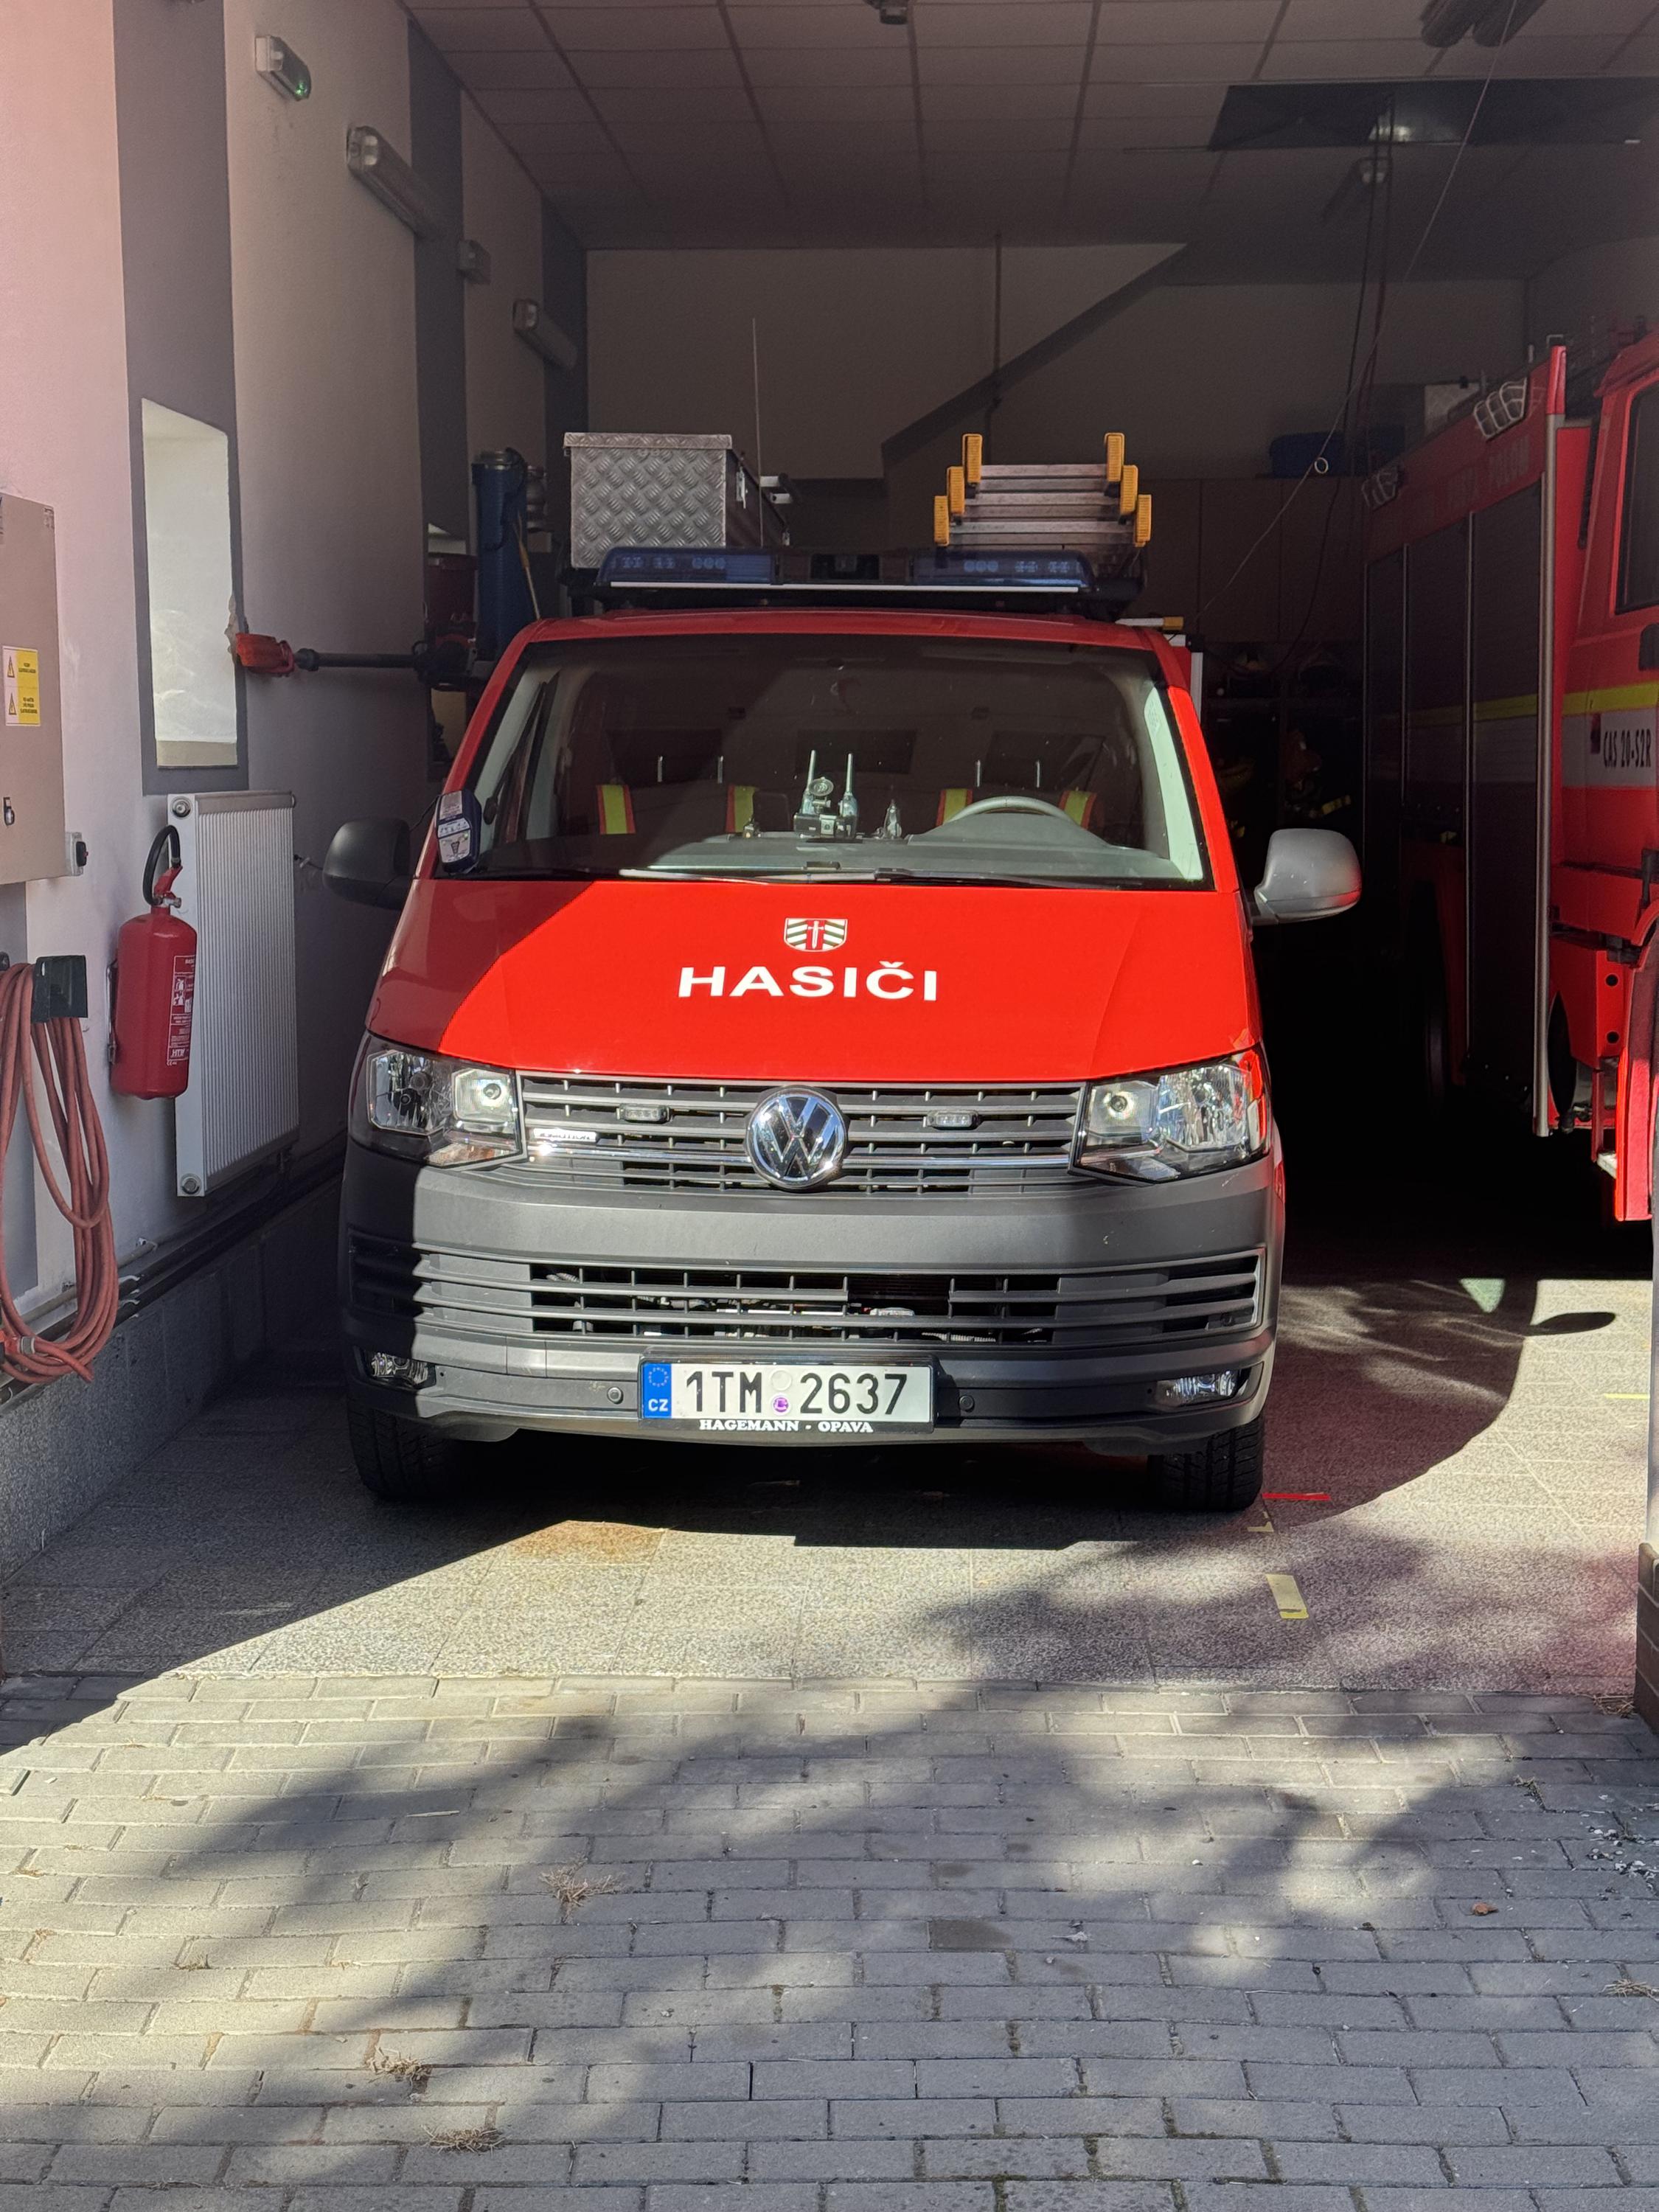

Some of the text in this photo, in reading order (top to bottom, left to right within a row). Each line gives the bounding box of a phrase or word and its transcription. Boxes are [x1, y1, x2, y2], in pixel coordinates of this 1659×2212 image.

[1603, 731, 1618, 768] CAS
[678, 960, 938, 1001] HASIČI
[647, 1398, 669, 1413] CZ
[686, 1371, 908, 1415] 1TM 2637
[699, 1419, 799, 1432] HAGEMANN
[818, 1421, 874, 1433] OPAVA
